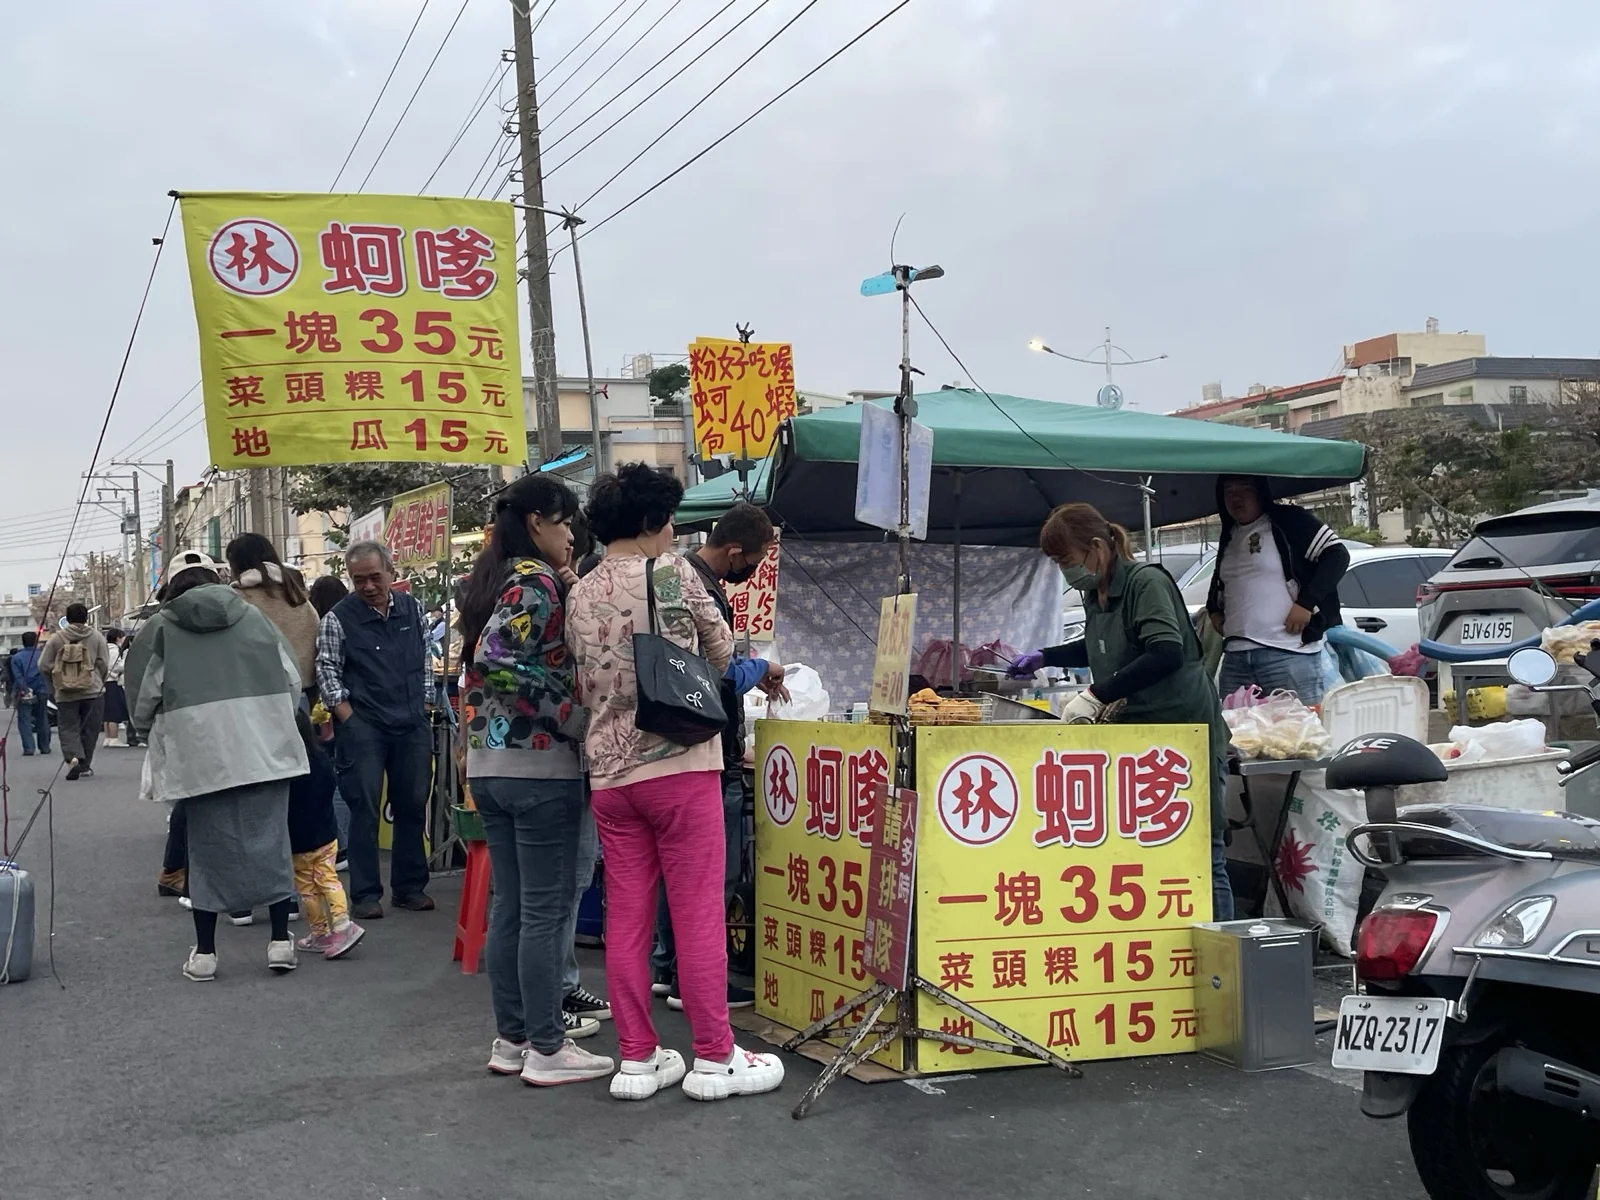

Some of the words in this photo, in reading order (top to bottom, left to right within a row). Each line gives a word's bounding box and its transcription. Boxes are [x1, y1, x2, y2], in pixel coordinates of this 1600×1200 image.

[226, 228, 291, 286] 林
[321, 223, 496, 297] 蚵嗲
[221, 310, 503, 360] 一塊35元
[227, 370, 505, 407] 菜頭粿15元
[690, 345, 793, 384] 粉好吃喔
[730, 400, 765, 448] 40
[765, 384, 796, 421] 蝦
[769, 754, 796, 816] 林
[951, 765, 1010, 833] 林
[1036, 748, 1189, 844] 蚵嗲
[873, 798, 903, 972] 請排隊
[938, 864, 1193, 926] 一塊35元
[939, 941, 1196, 991] 菜頭粿15元
